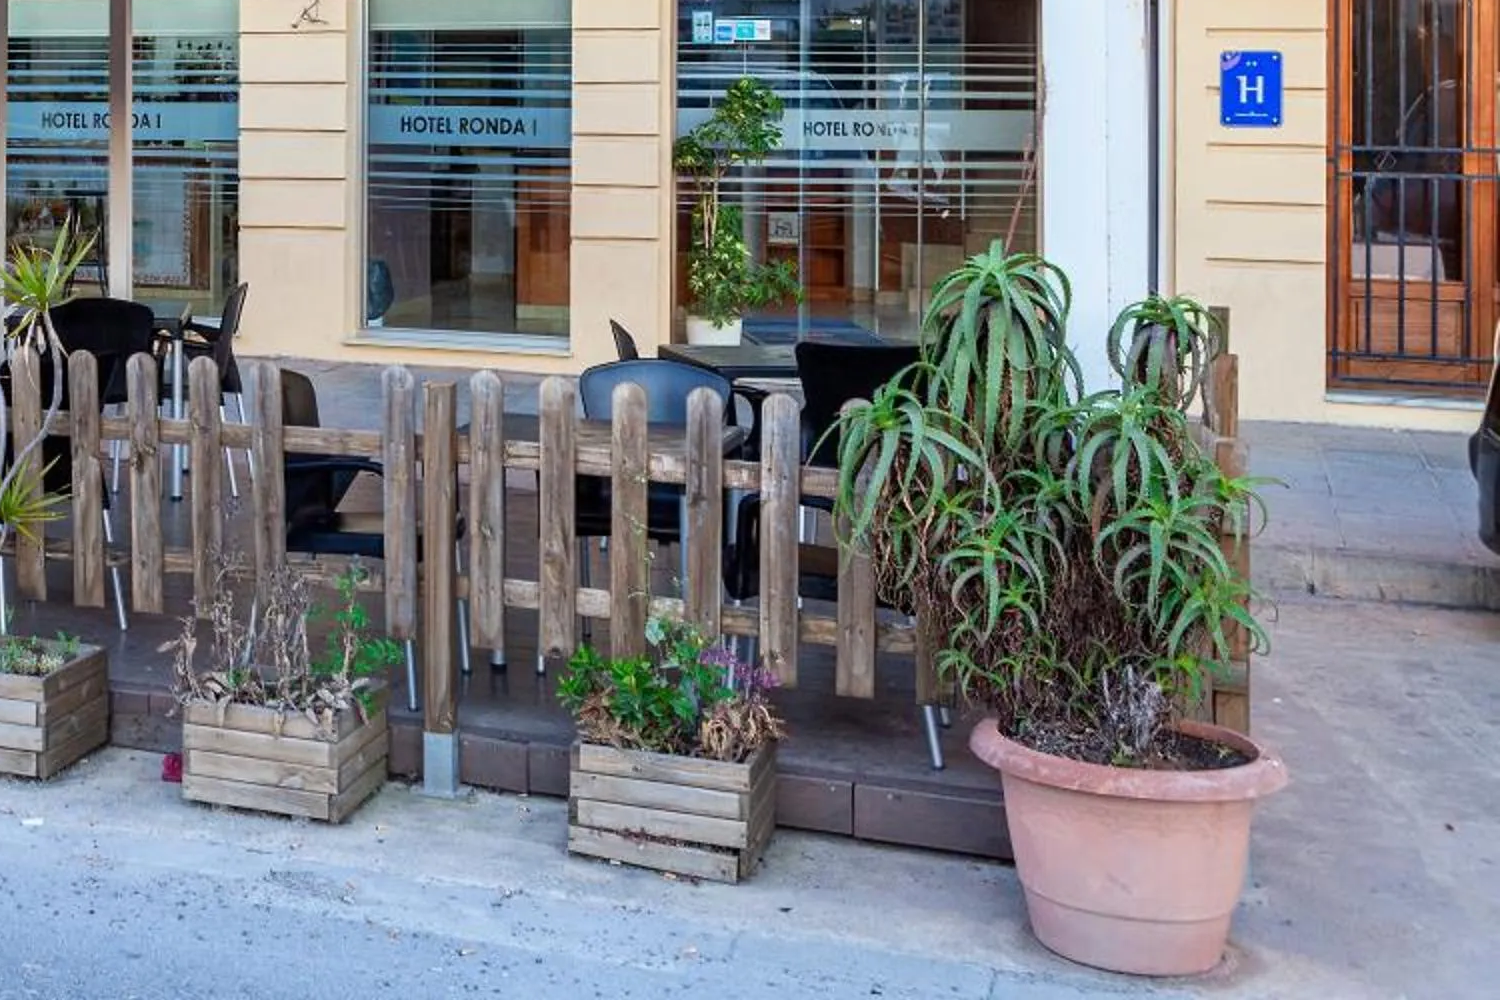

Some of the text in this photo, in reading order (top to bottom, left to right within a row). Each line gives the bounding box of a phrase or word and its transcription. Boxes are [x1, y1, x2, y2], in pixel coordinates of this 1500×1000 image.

[1235, 75, 1264, 103] H
[42, 112, 88, 129] HOTEL
[93, 113, 151, 129] RODA
[401, 116, 452, 134] HOTEL
[459, 117, 526, 135] RONDA
[803, 121, 848, 136] HOTEL
